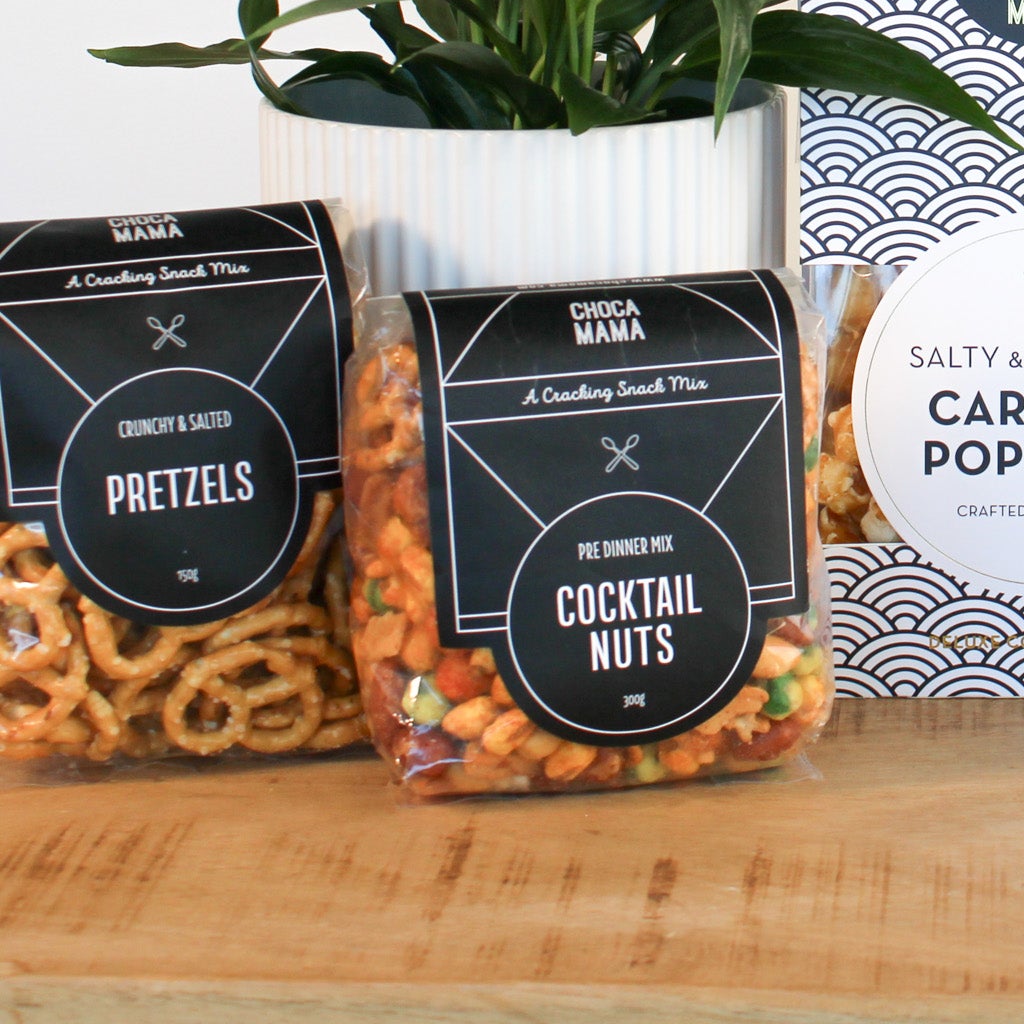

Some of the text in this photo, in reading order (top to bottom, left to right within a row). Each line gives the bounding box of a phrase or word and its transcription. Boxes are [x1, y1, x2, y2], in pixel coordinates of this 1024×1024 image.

[108, 213, 178, 227] CHOCA
[112, 223, 184, 243] MAMA
[64, 262, 250, 289] A Cracking Snack Mix
[569, 298, 641, 320] CHOCA
[573, 318, 646, 345] MAMA
[910, 346, 999, 368] SALTY
[1008, 351, 1023, 368] &
[521, 376, 708, 405] A Cracking Snack Mix
[118, 410, 232, 438] CRUNCHY & SALTED
[106, 460, 254, 515] PRETZELS
[578, 534, 674, 560] PRE DINNER MIX
[556, 573, 703, 627] COCKTAIL
[590, 623, 675, 672] NUTS
[928, 634, 1001, 649] DELUXE
[622, 693, 646, 708] 300g
